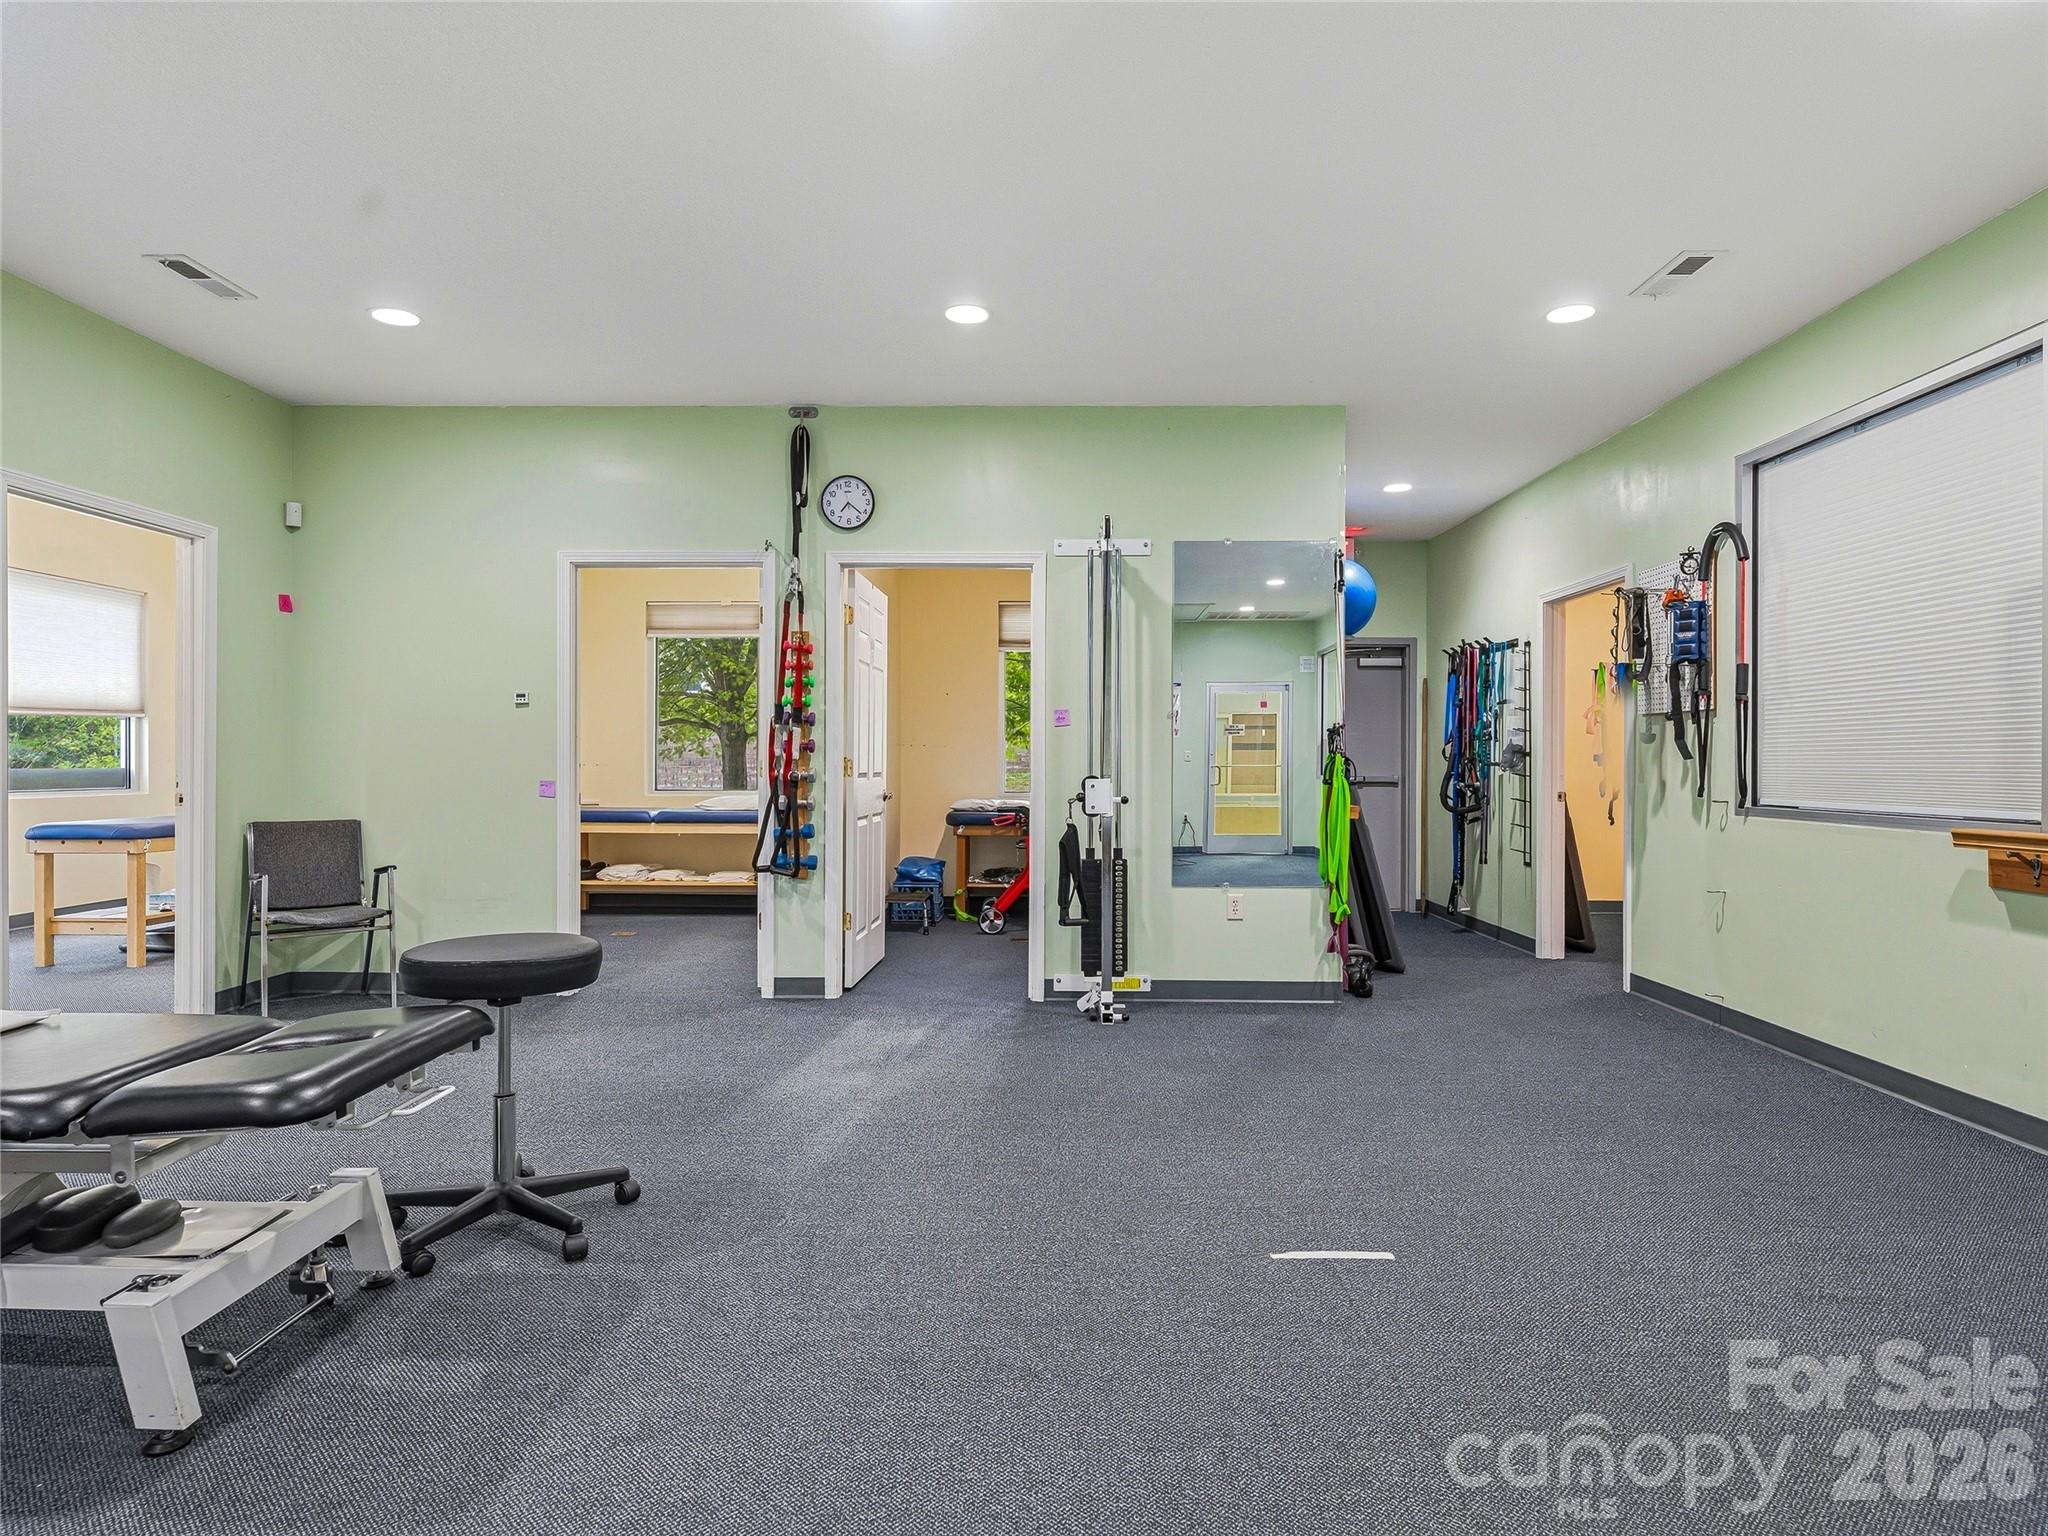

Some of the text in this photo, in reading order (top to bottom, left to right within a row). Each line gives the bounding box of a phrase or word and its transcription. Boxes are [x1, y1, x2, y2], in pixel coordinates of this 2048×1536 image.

[844, 480, 852, 488] 12
[829, 490, 836, 498] 10
[862, 489, 867, 497] 2
[847, 518, 852, 526] 6
[856, 515, 861, 523] 5
